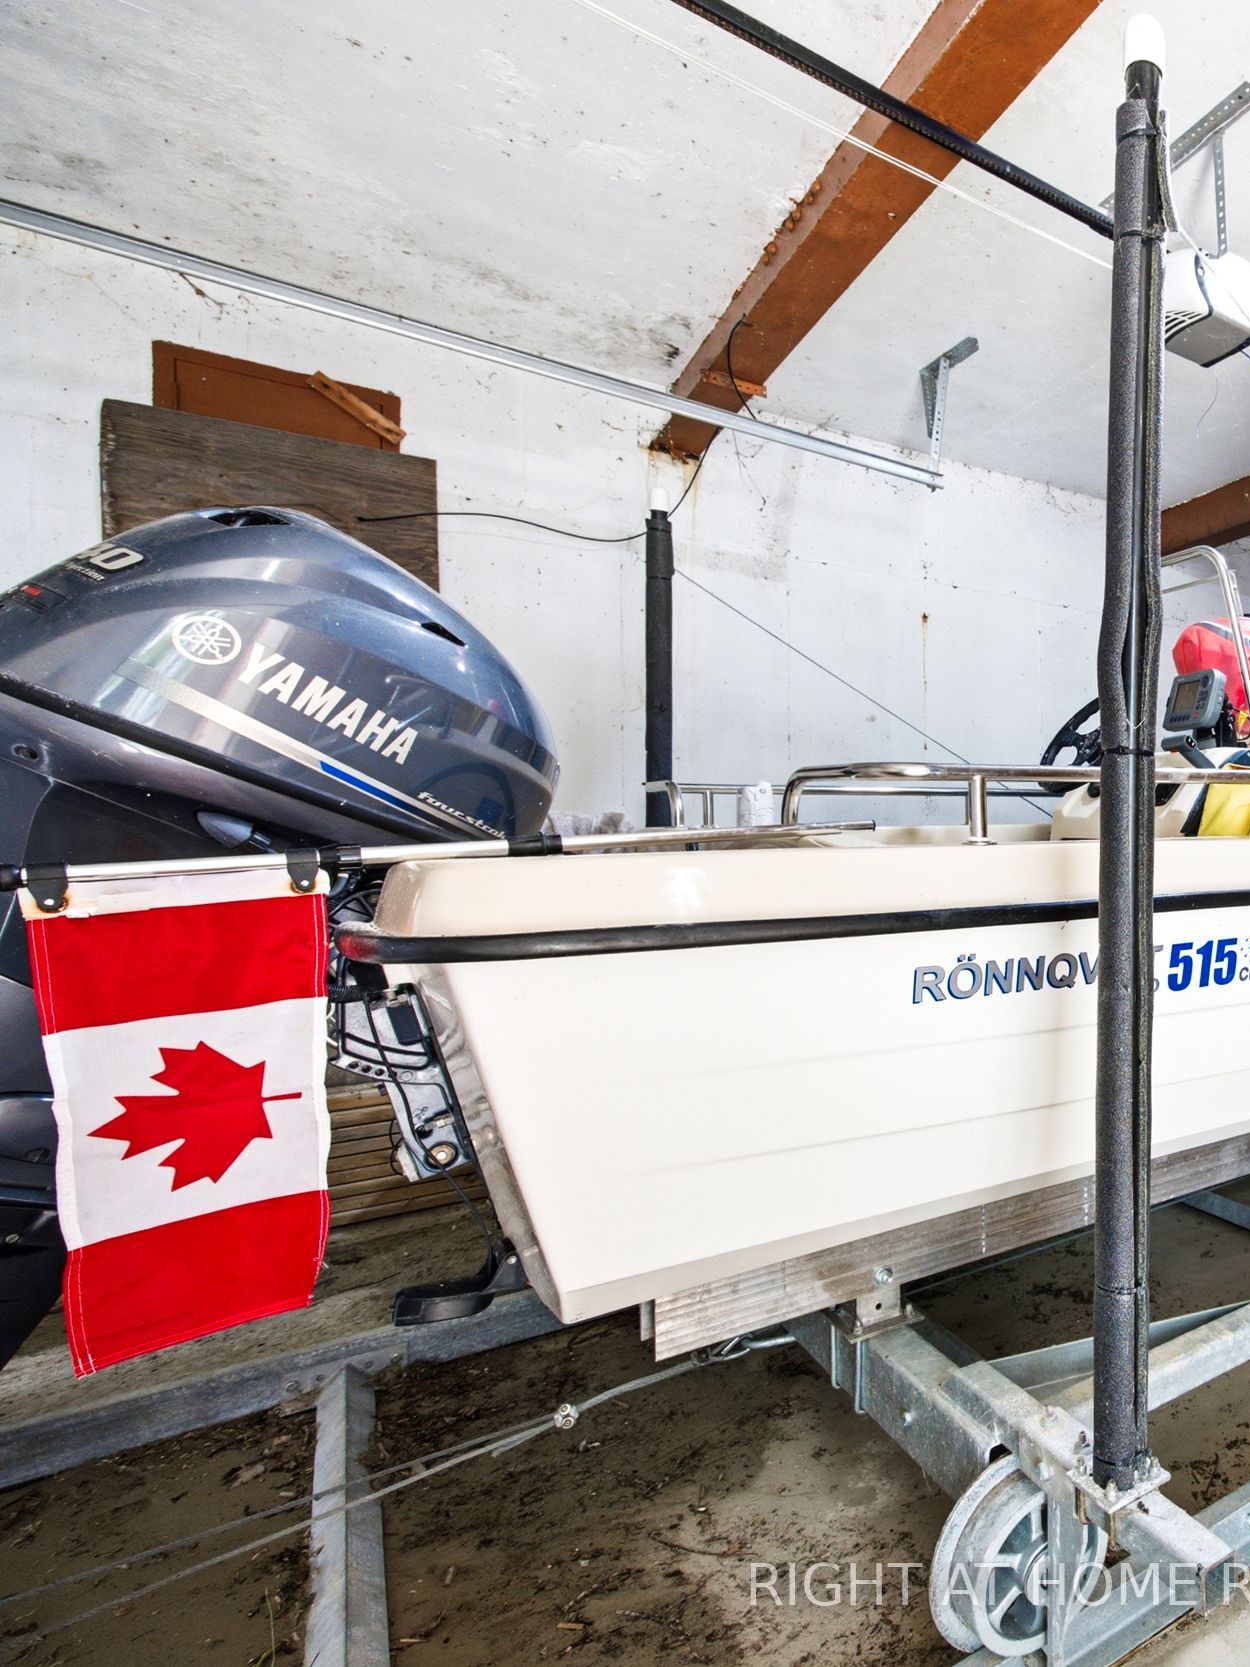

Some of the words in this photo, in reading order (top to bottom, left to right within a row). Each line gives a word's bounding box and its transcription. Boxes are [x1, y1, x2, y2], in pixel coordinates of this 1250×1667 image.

[238, 642, 418, 765] YAMAHA
[912, 945, 1164, 1004] RÖNNQV
[1167, 937, 1239, 992] 515
